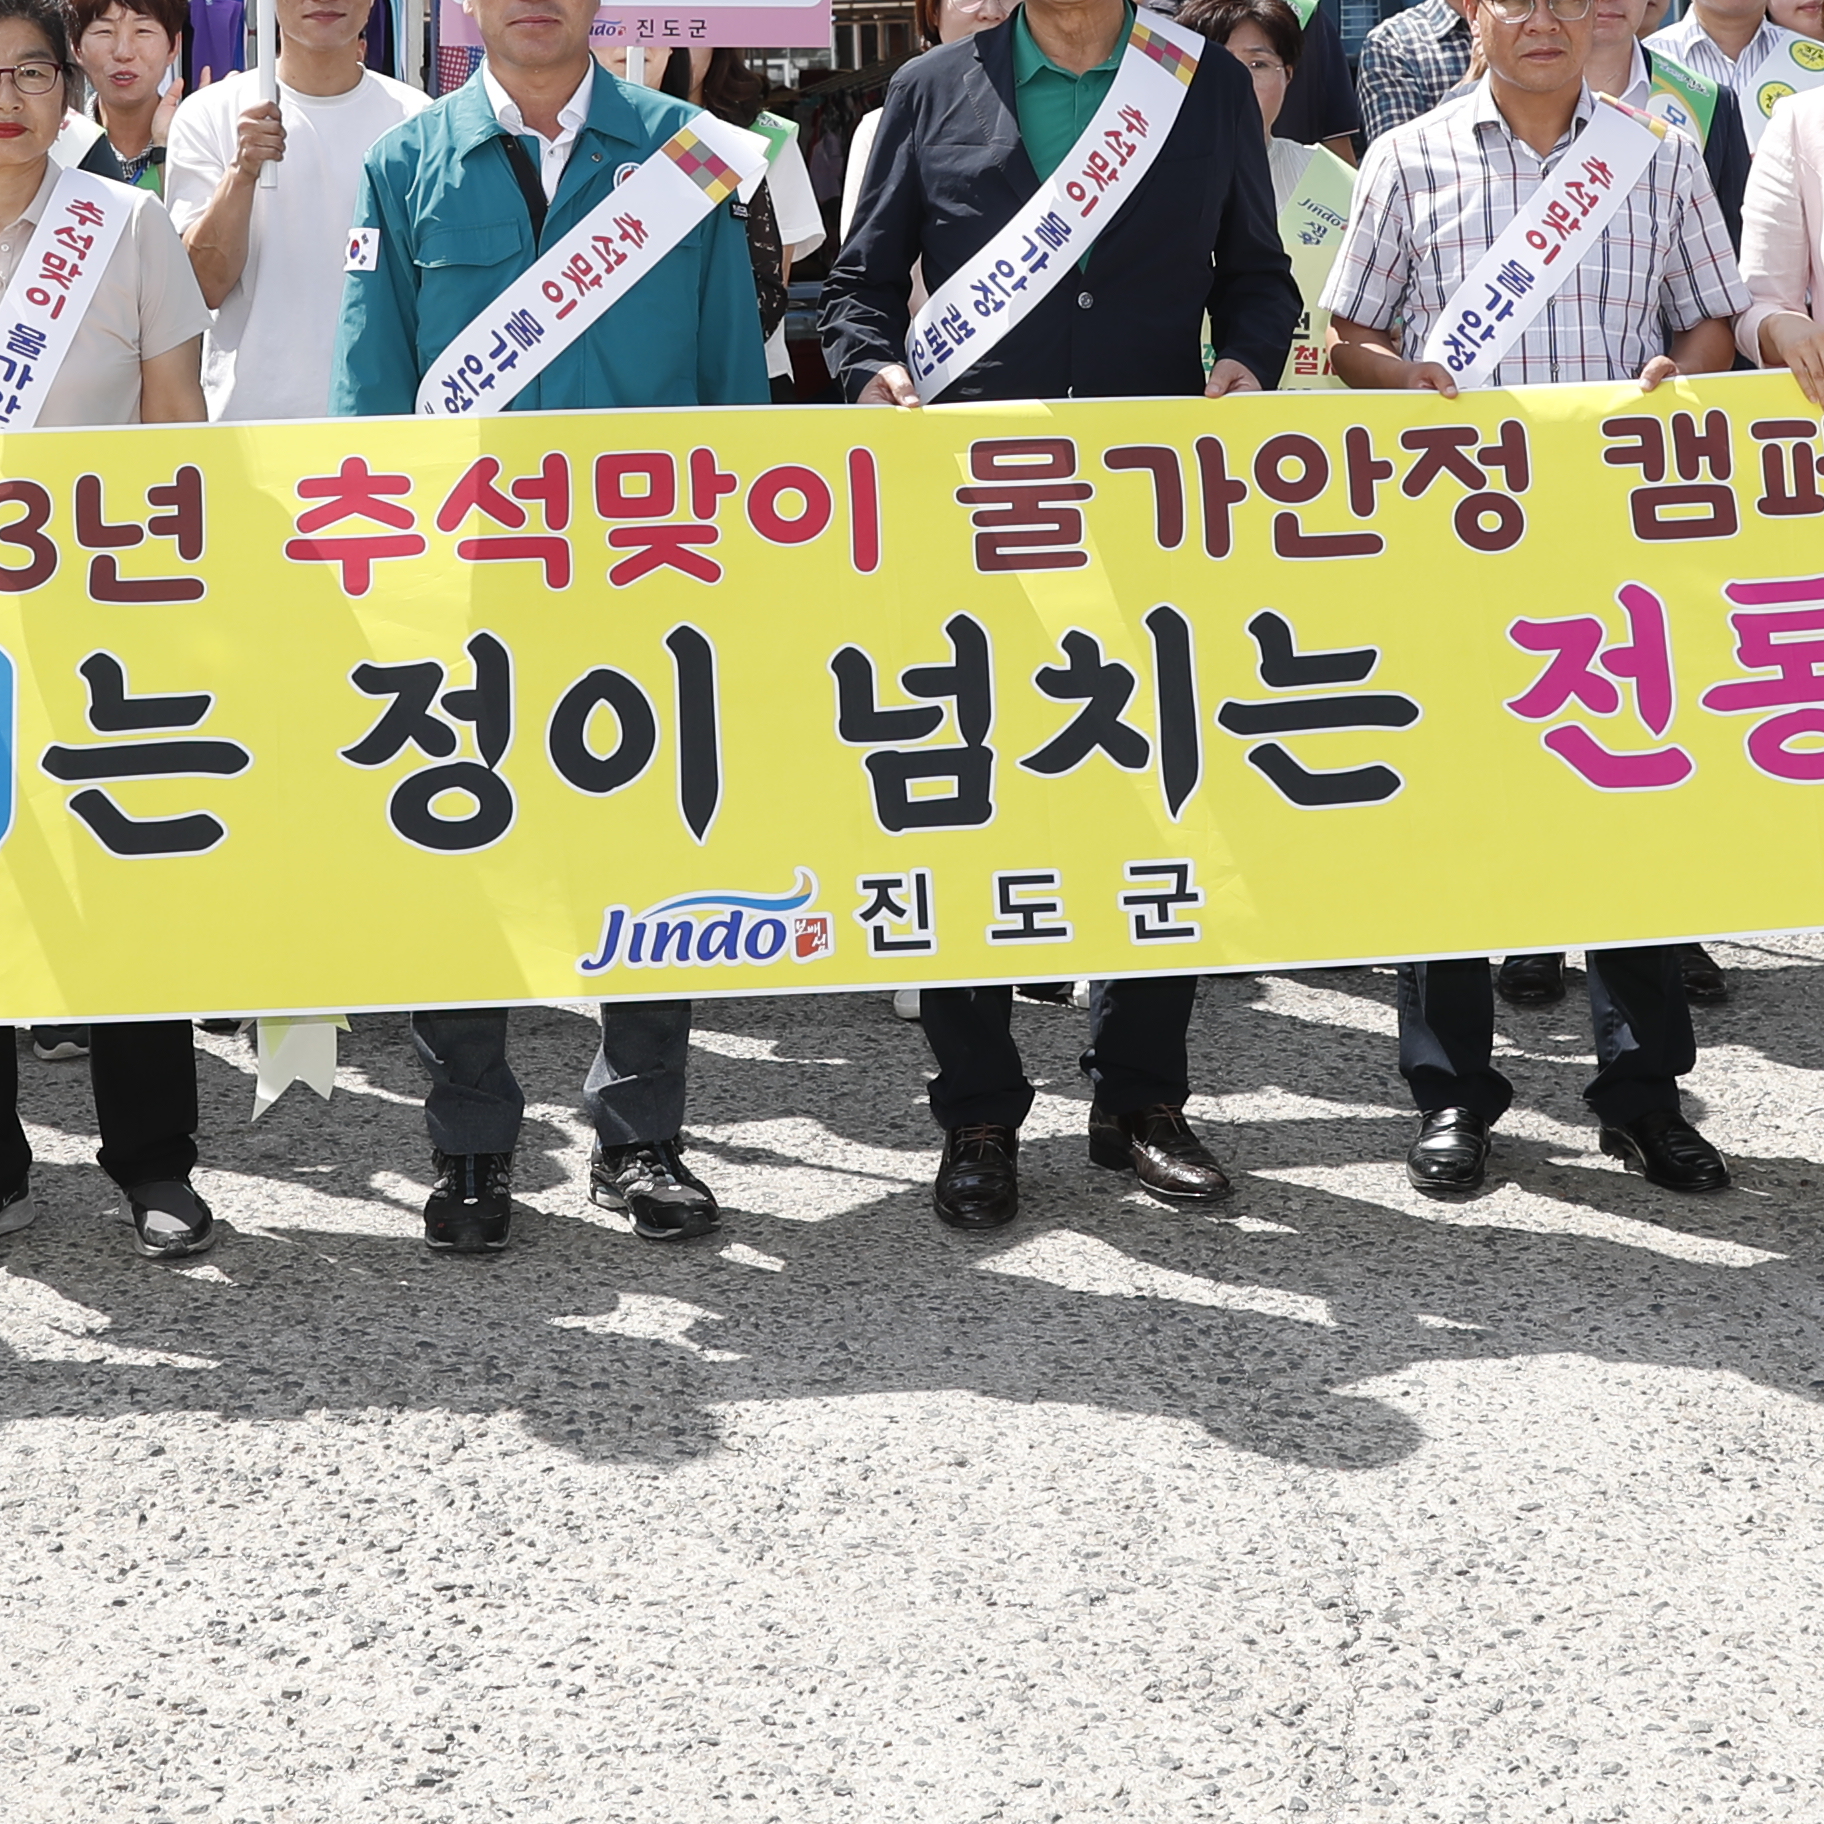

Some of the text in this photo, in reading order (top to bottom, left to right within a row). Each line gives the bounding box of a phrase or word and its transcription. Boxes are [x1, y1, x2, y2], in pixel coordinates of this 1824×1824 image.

[636, 19, 708, 39] 진도군
[24, 197, 107, 321] 추석맞이
[540, 211, 652, 323] 추석맞이
[909, 102, 1152, 383] 추석맞이 물가안정 캠페인
[1441, 154, 1617, 373] 추석맞이 물가안정
[284, 445, 881, 597] 추석맞이
[955, 416, 1532, 574] 물가안정
[340, 623, 723, 853] 정이
[830, 603, 1421, 835] 넘치는
[580, 907, 787, 972] Jindo
